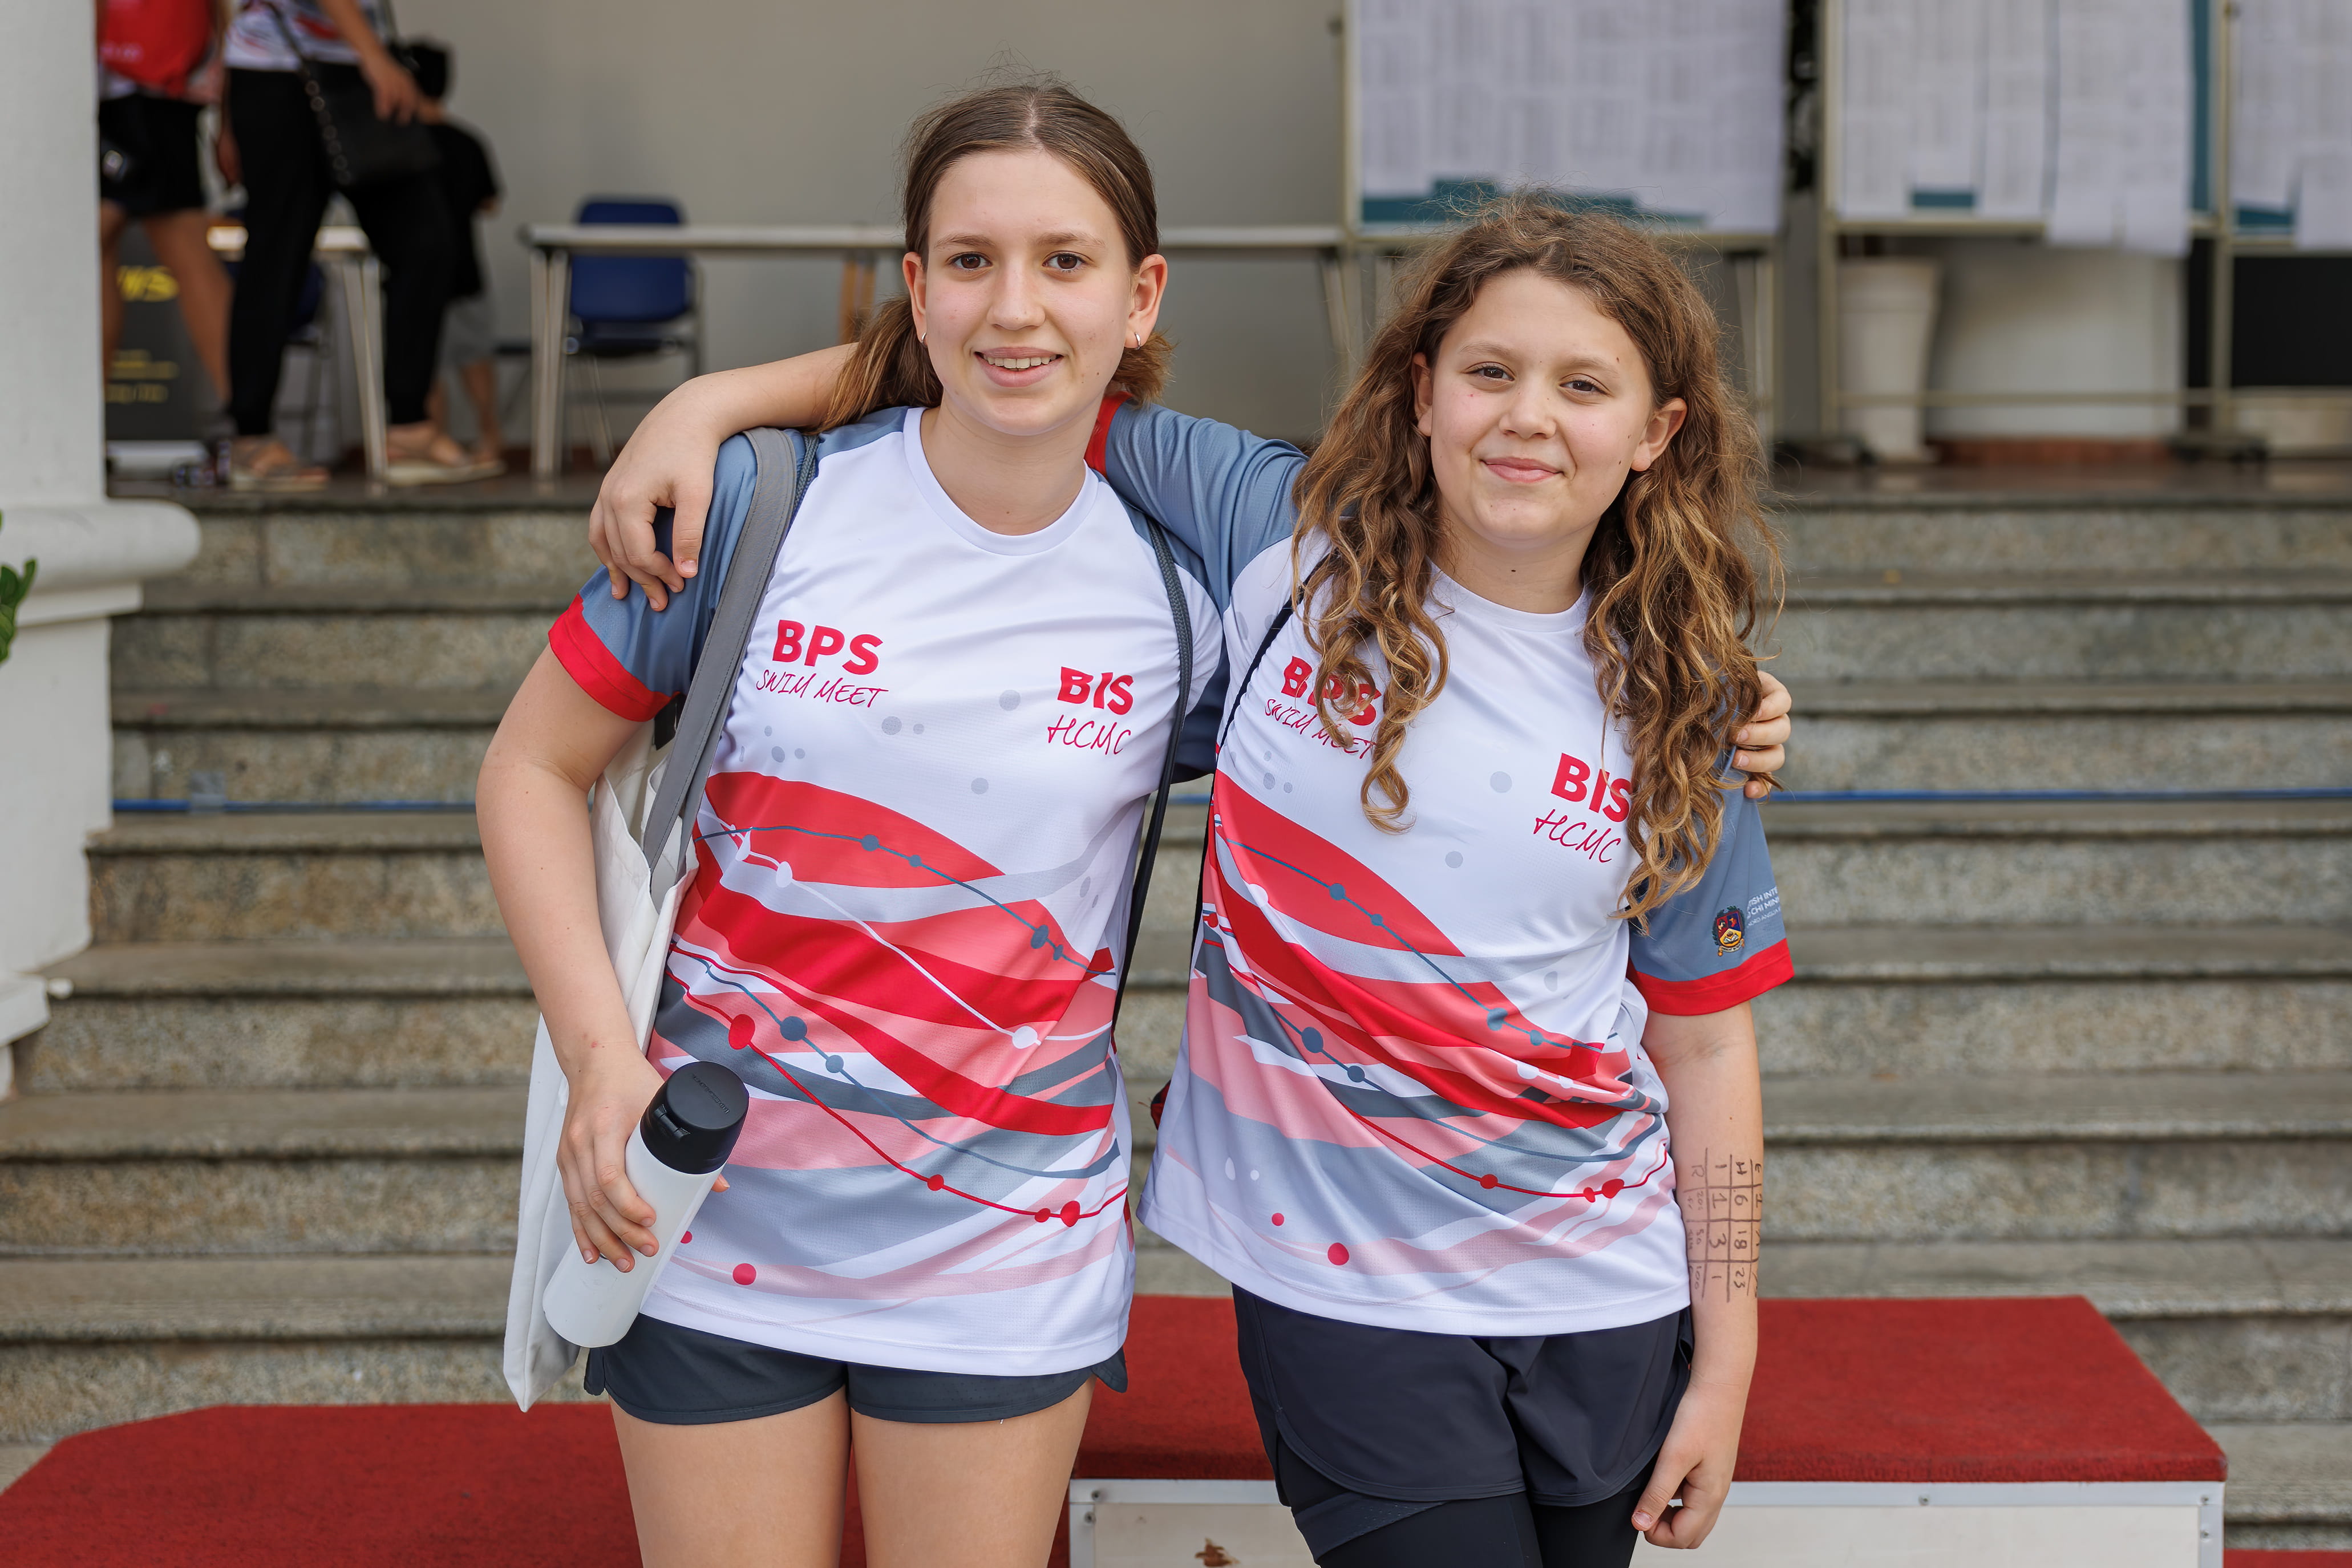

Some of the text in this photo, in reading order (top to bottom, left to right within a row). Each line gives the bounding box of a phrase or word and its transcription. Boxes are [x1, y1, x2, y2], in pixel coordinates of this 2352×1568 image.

[772, 619, 883, 675] BPS
[756, 670, 889, 708] SWIM MEET
[1057, 666, 1135, 715] BIS
[1281, 655, 1382, 726] BPS
[1047, 714, 1131, 755] HCMC
[1265, 699, 1318, 735] SWIM
[1551, 752, 1633, 823] BIS
[1533, 809, 1621, 863] HCMC
[1691, 1164, 1705, 1177] R
[1712, 1193, 1727, 1209] 1
[1709, 1233, 1727, 1249] 3
[1734, 1161, 1748, 1288] H 6 18 23
